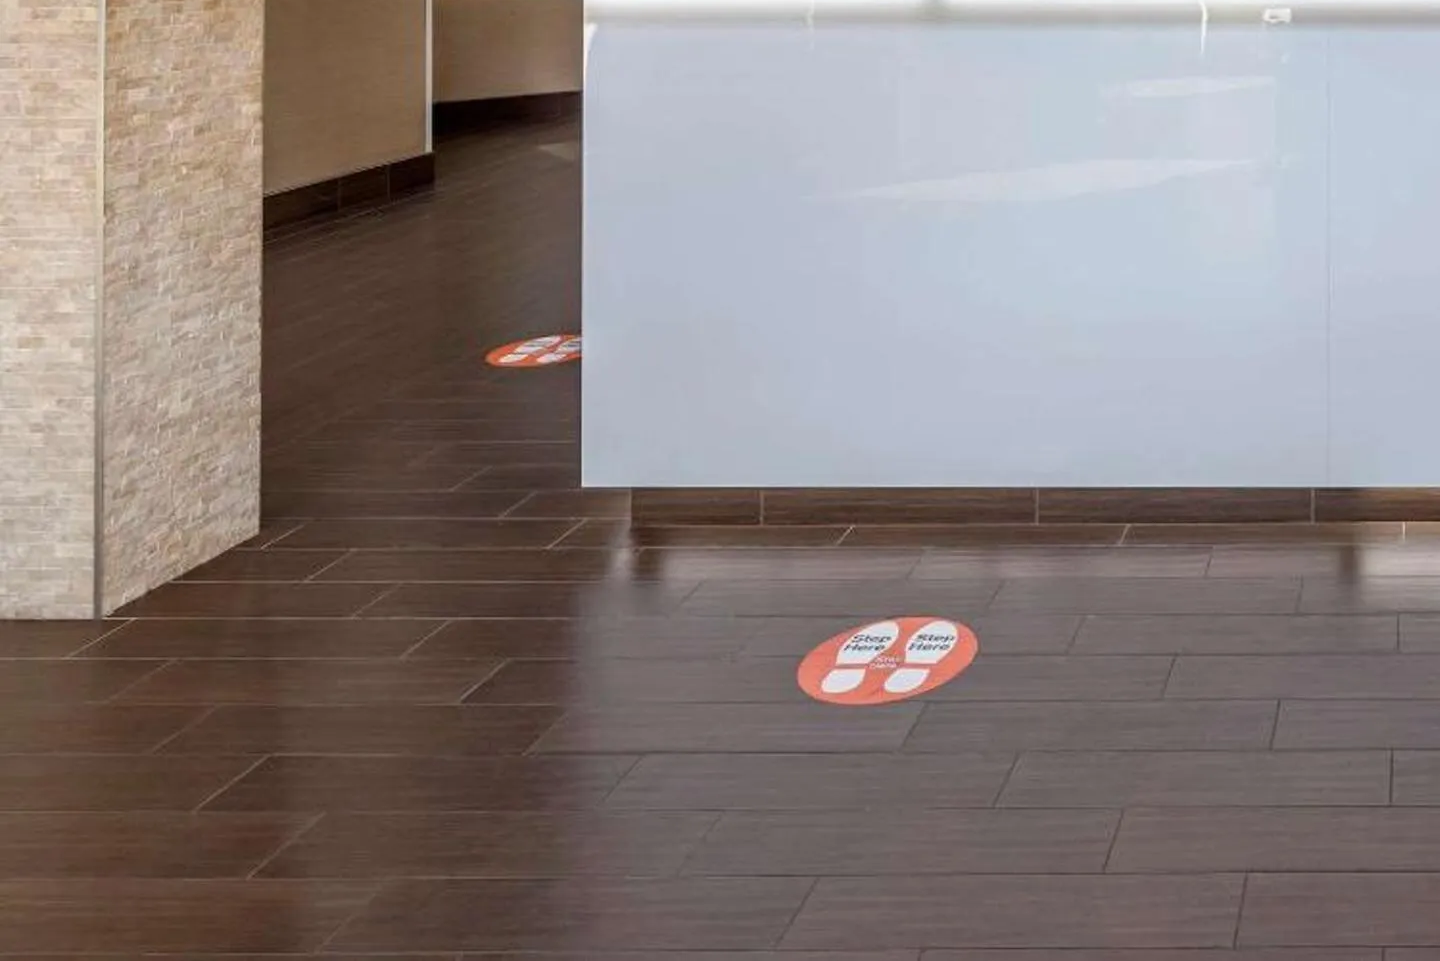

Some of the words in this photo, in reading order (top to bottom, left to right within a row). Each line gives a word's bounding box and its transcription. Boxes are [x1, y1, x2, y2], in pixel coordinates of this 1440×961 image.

[851, 634, 892, 644] Step
[915, 634, 955, 644] Step
[843, 642, 886, 651] Here
[908, 642, 950, 651] Here
